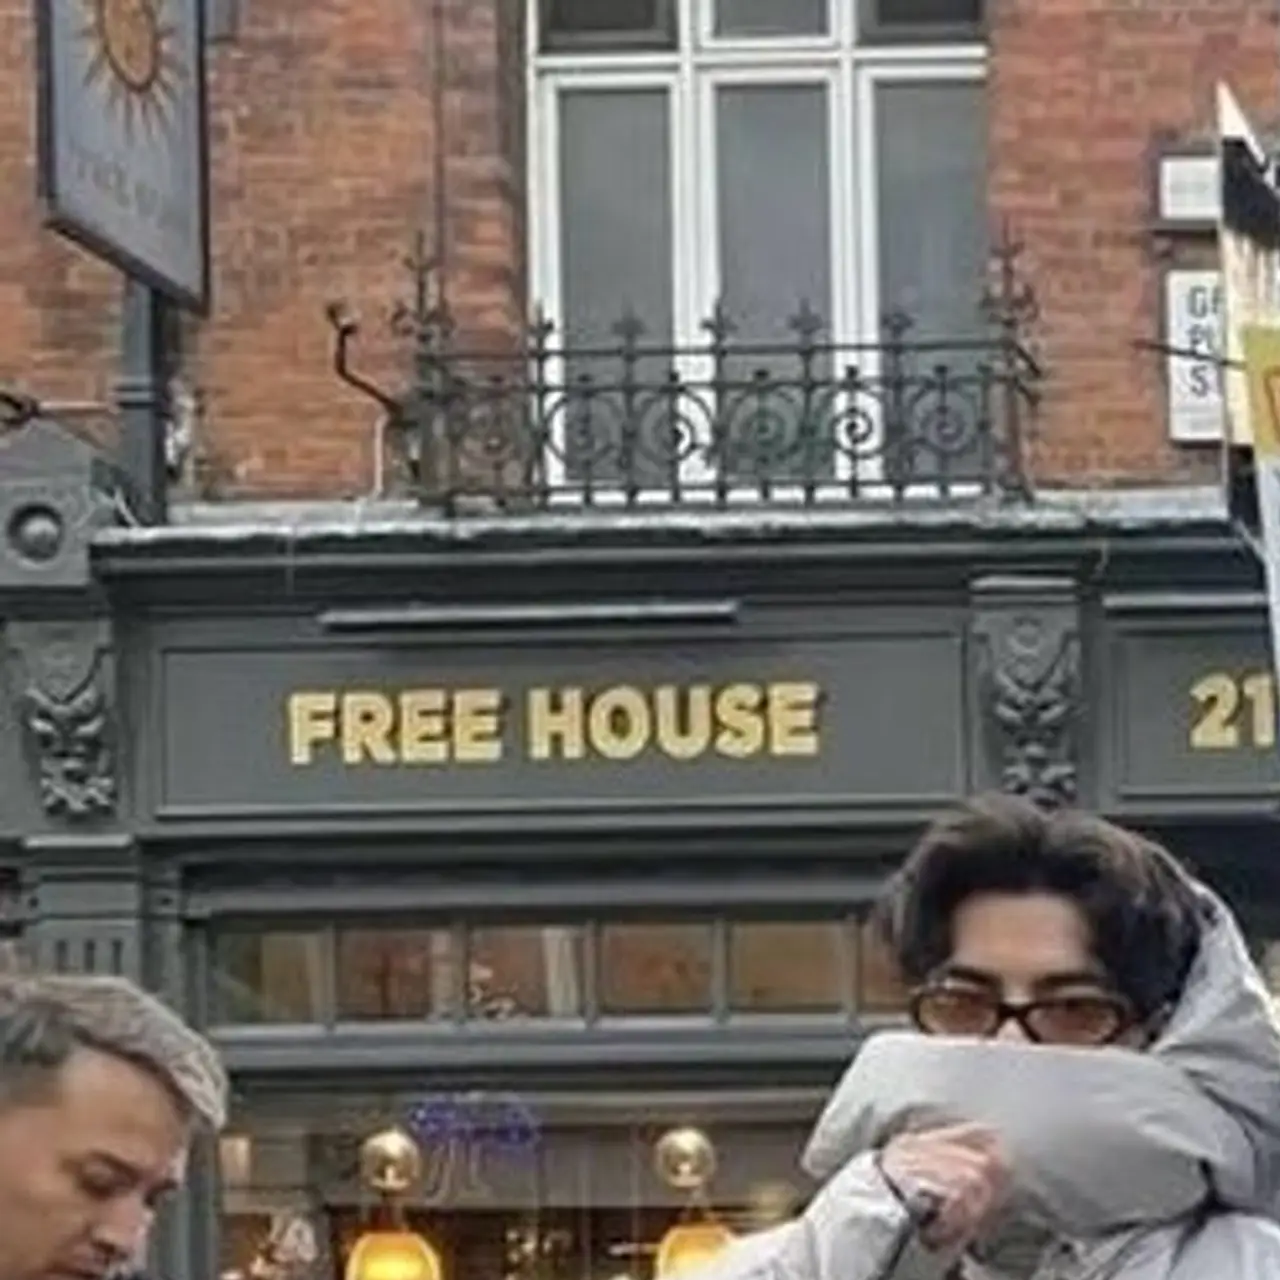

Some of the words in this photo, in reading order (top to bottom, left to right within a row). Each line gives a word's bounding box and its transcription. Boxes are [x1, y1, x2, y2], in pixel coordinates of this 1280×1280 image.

[289, 689, 504, 766] FREE
[527, 682, 820, 760] HOUSE
[1188, 672, 1276, 749] 21
